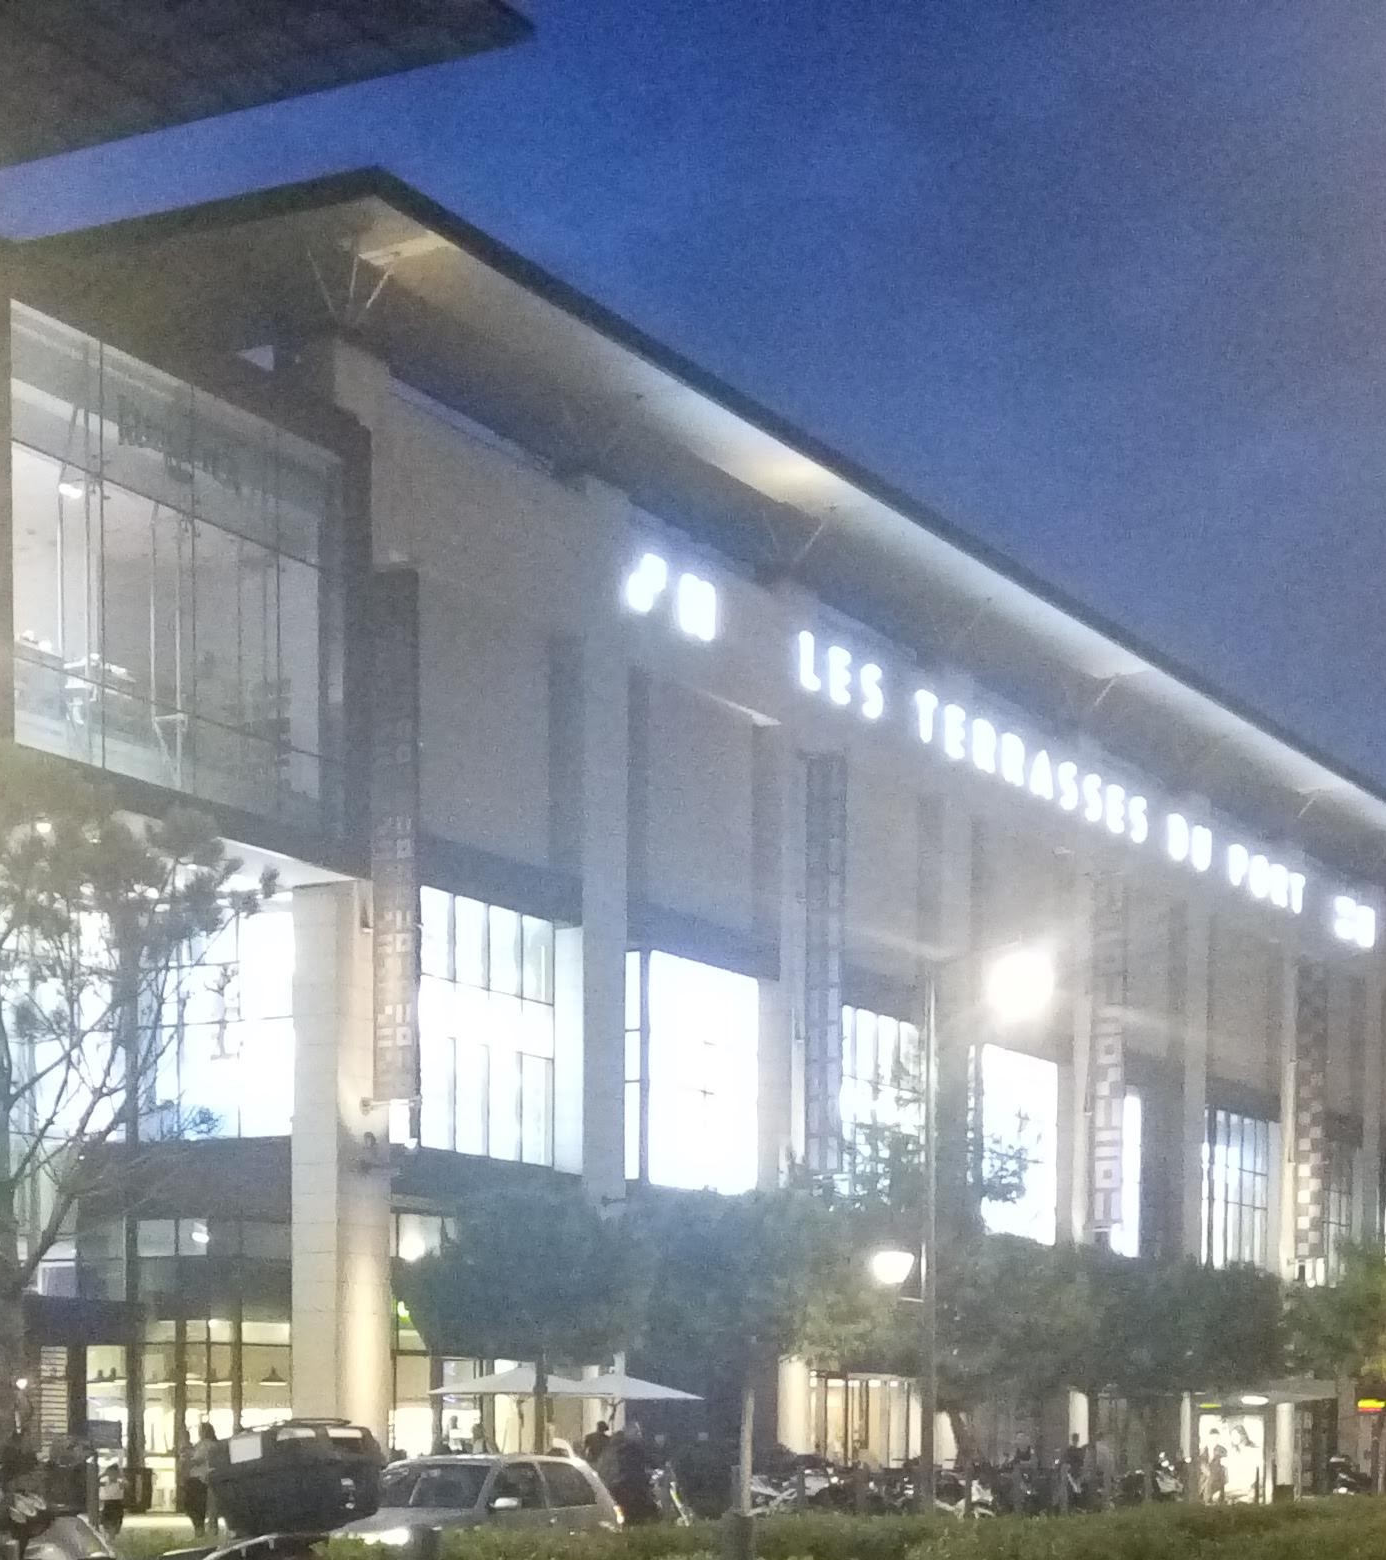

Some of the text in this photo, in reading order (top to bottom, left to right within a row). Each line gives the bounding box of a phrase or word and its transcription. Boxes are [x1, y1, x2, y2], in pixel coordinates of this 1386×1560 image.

[798, 630, 1306, 914] LES TERRASSES DU PORT
